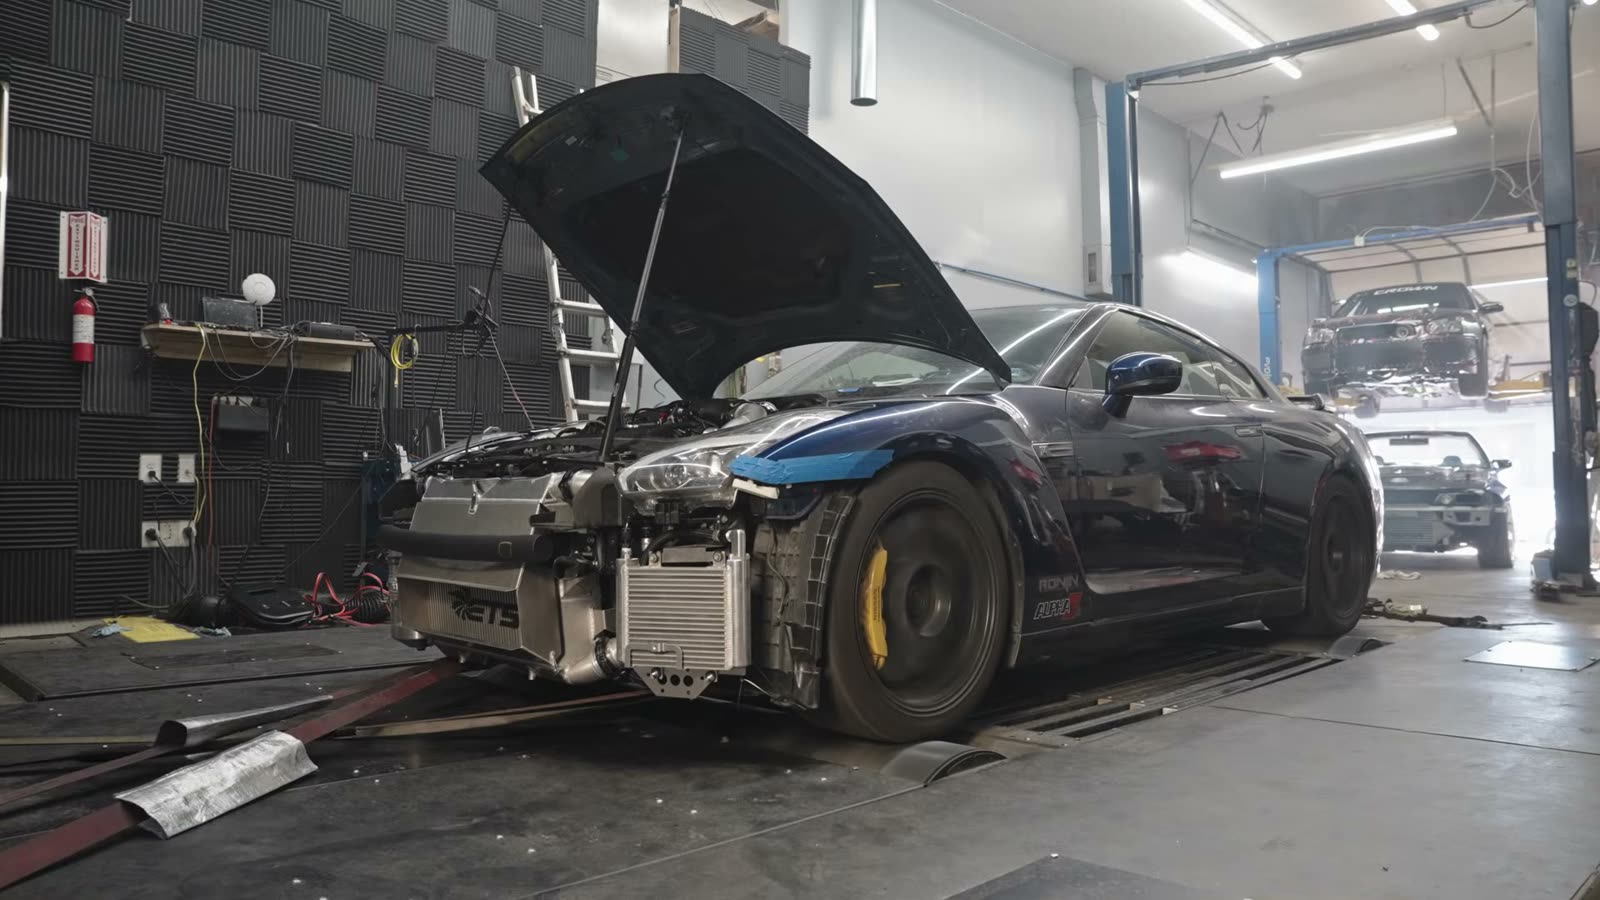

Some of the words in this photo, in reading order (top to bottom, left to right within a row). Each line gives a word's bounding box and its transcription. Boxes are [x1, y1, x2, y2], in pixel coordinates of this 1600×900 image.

[1373, 285, 1438, 296] CROWN
[1039, 575, 1079, 592] RONIN
[464, 599, 519, 630] ETS
[1033, 598, 1071, 620] ALPHA
